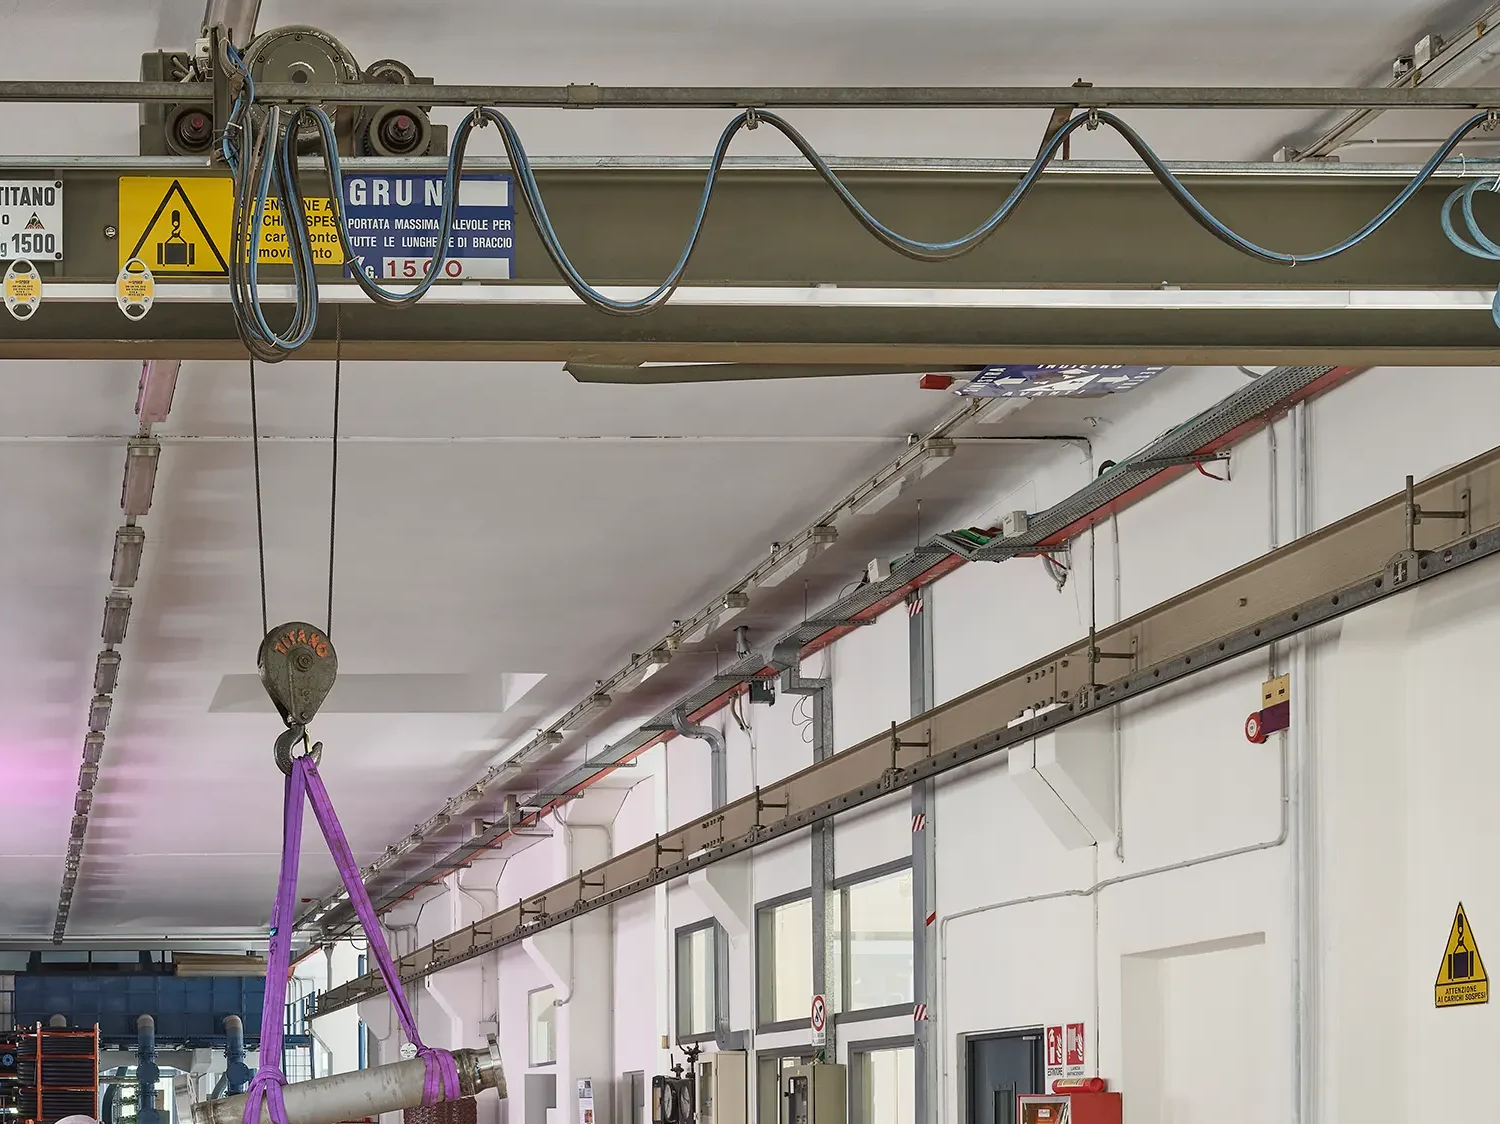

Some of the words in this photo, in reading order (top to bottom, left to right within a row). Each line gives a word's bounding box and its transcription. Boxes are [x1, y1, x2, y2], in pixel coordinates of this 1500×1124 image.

[350, 179, 413, 206] GRU
[348, 218, 390, 230] PORTATA
[394, 219, 440, 230] MASSIMA
[492, 220, 511, 231] PER
[11, 233, 56, 253] 1500
[349, 236, 377, 247] TUTTE
[383, 236, 395, 248] LE
[401, 236, 455, 248] LUNGHEE
[457, 237, 468, 248] DI
[472, 237, 512, 249] BRACCIO
[274, 628, 329, 658] TITANO
[1445, 985, 1477, 995] ATTENZIONE
[1437, 995, 1443, 1003] AI
[1465, 991, 1486, 1001] SOSPESI
